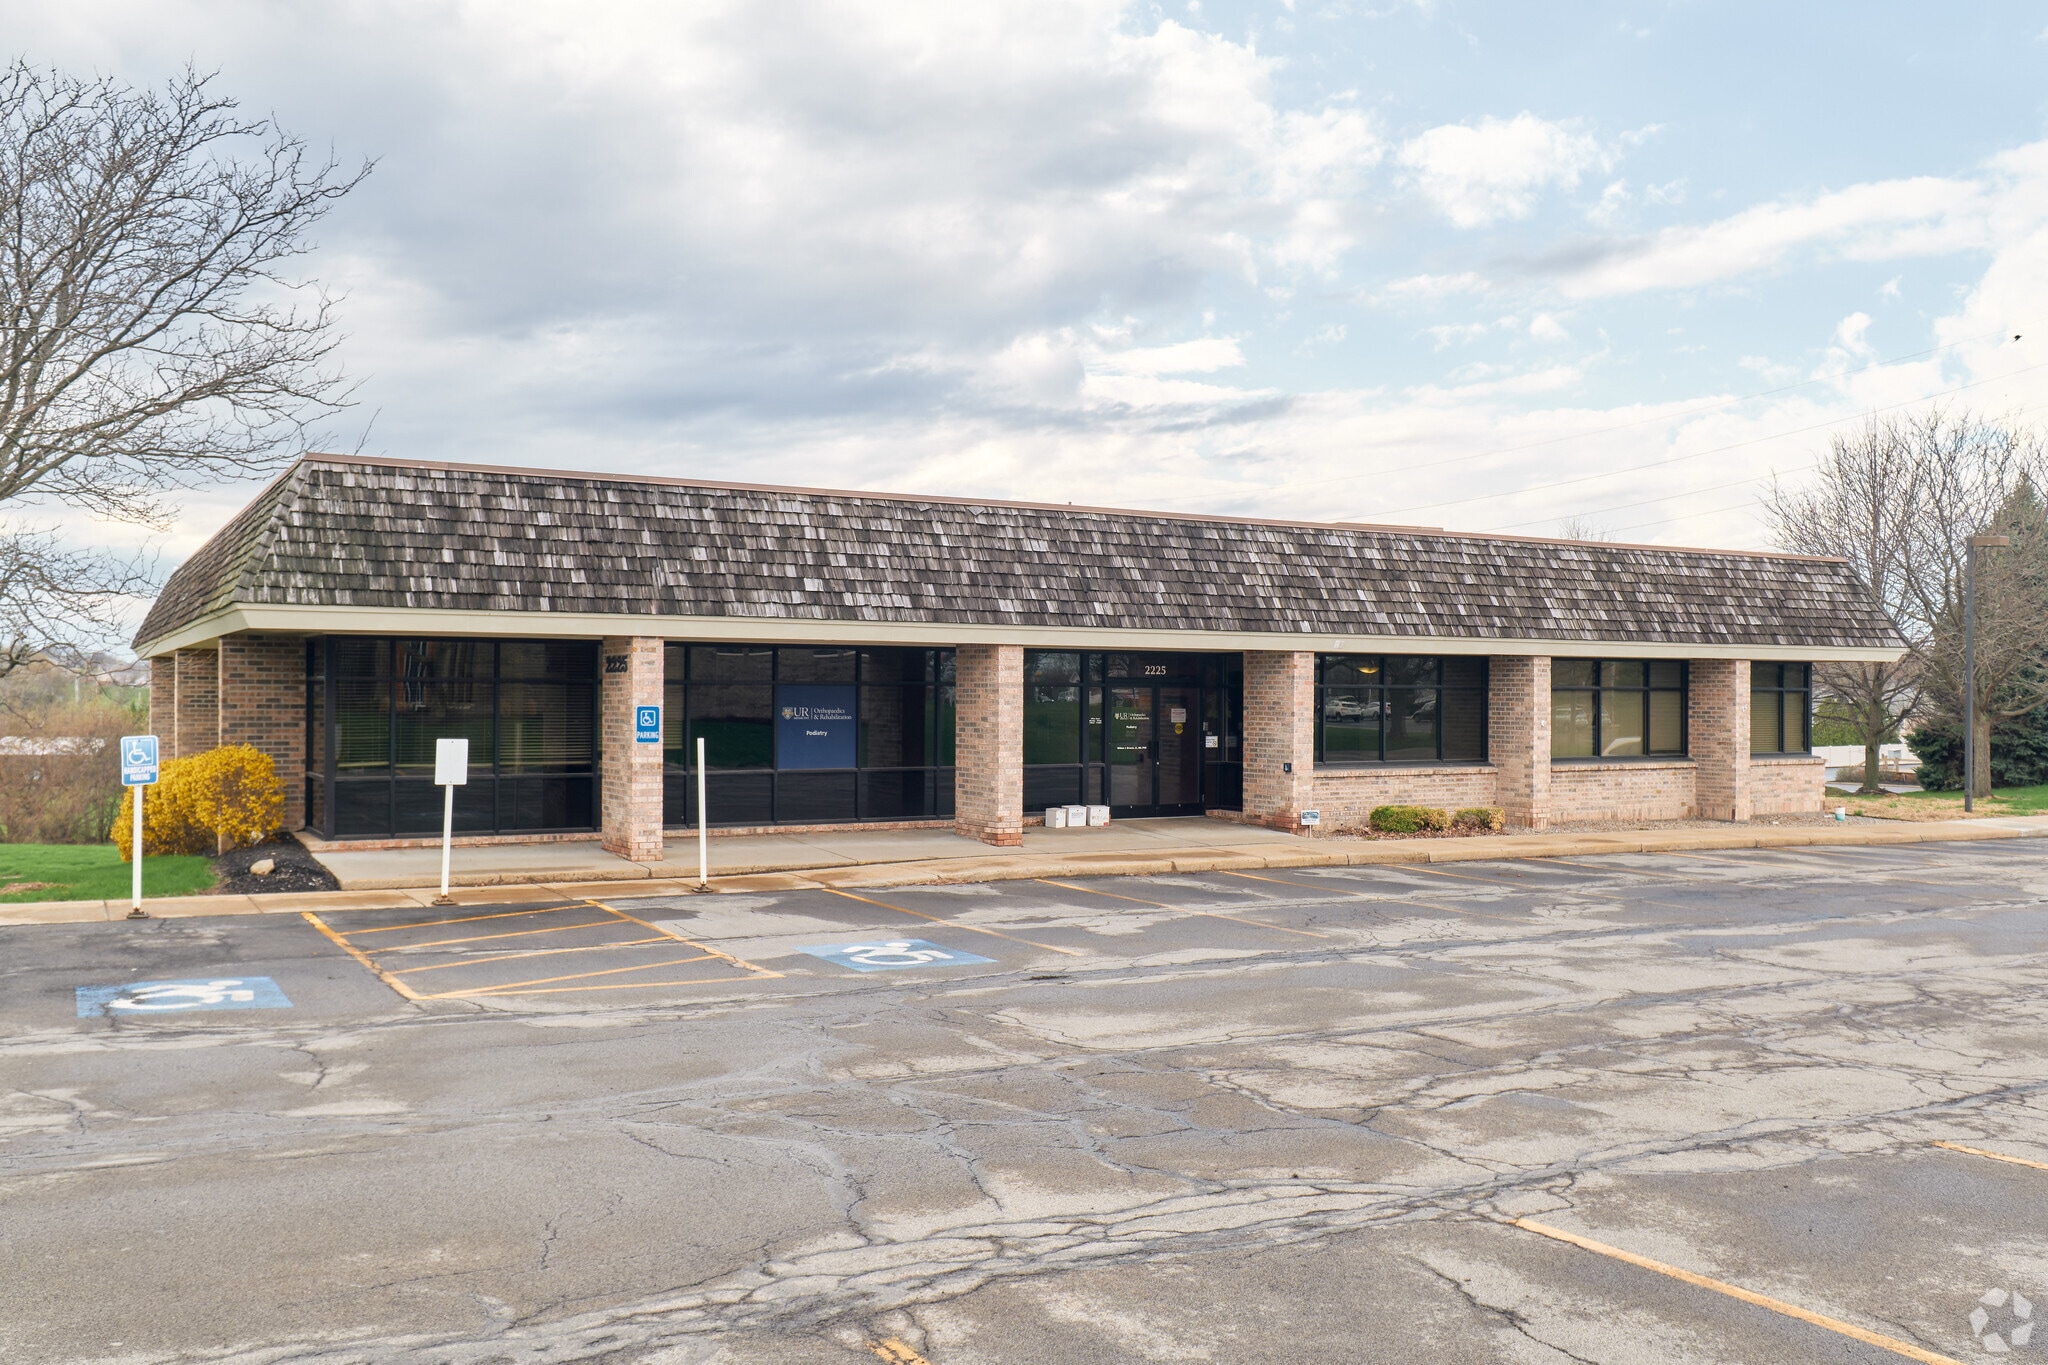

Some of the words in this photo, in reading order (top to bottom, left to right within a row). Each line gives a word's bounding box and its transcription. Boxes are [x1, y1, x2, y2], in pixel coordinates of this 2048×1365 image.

[605, 654, 628, 673] 2225
[1144, 665, 1167, 675] 2225
[794, 707, 809, 717] UR
[814, 707, 845, 716] Orthopaedics
[637, 731, 659, 739] PARKING
[123, 766, 157, 774] HANDICAPPED
[130, 773, 151, 782] PARKING
